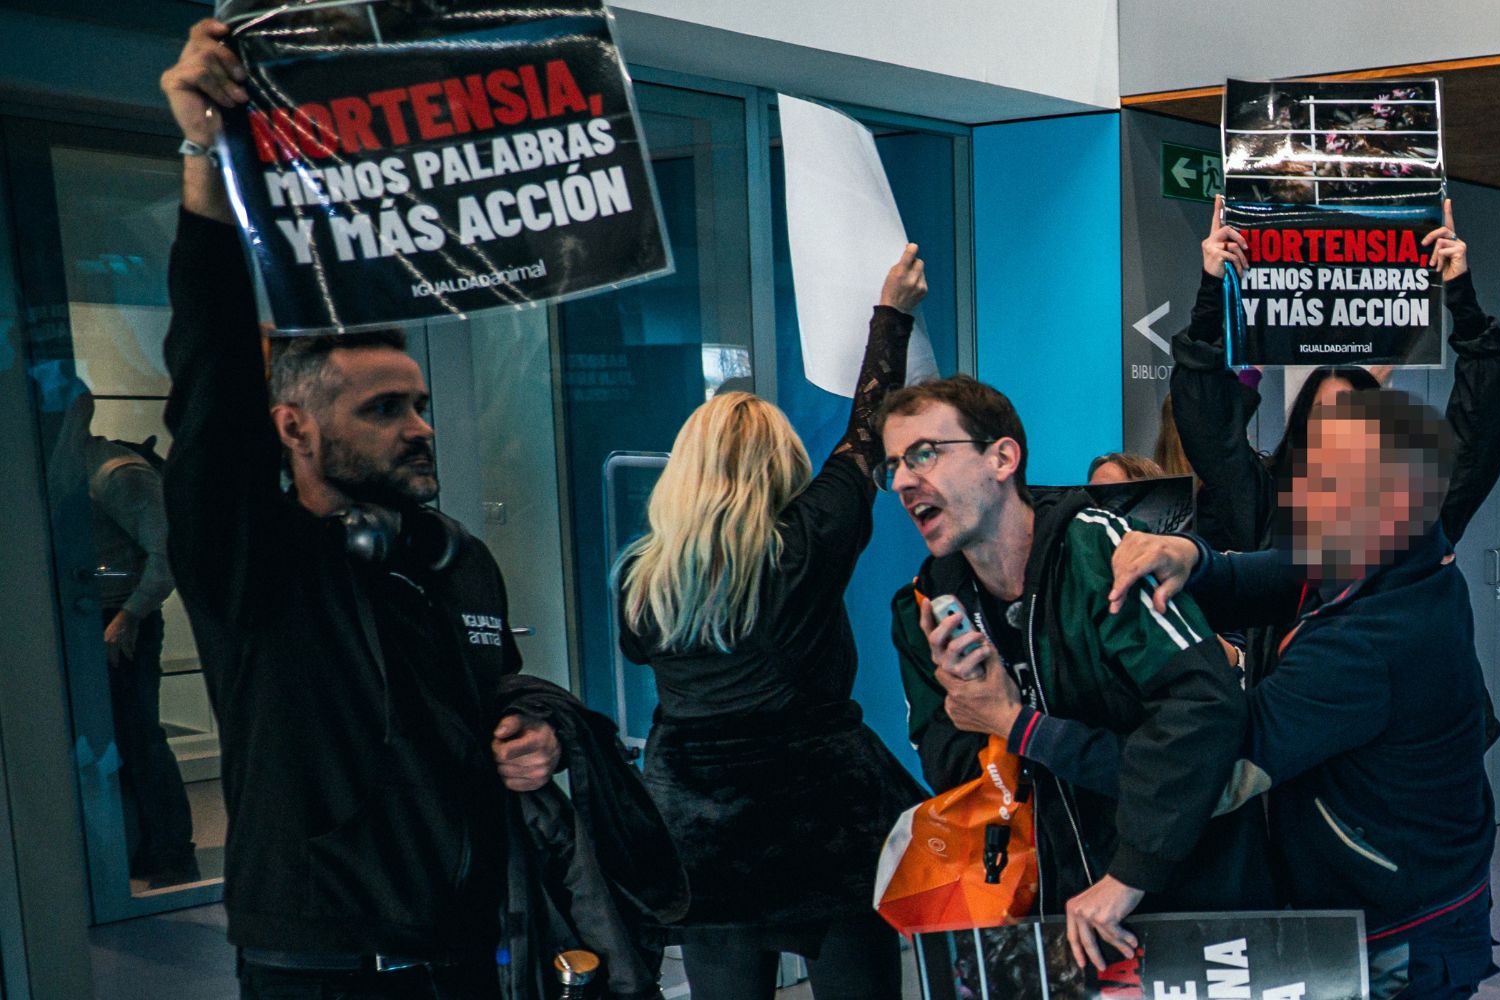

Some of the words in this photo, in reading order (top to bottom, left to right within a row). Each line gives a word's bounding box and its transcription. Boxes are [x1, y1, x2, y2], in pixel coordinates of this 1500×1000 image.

[249, 59, 603, 162] HORTENSIA,
[264, 157, 410, 206] MENOS
[413, 118, 616, 189] PALABRAS
[275, 219, 314, 263] Y
[329, 199, 446, 261] MÁS
[457, 163, 632, 244] ACCIÓN
[1240, 229, 1429, 267] HORTENSIA,
[1241, 268, 1313, 291] MENOS
[1318, 268, 1430, 291] PALABRAS
[1242, 298, 1259, 326] Y
[1267, 291, 1324, 326] MÁS
[1330, 291, 1430, 327] ACCIÓN
[1300, 342, 1373, 353] IGUALDADanimal
